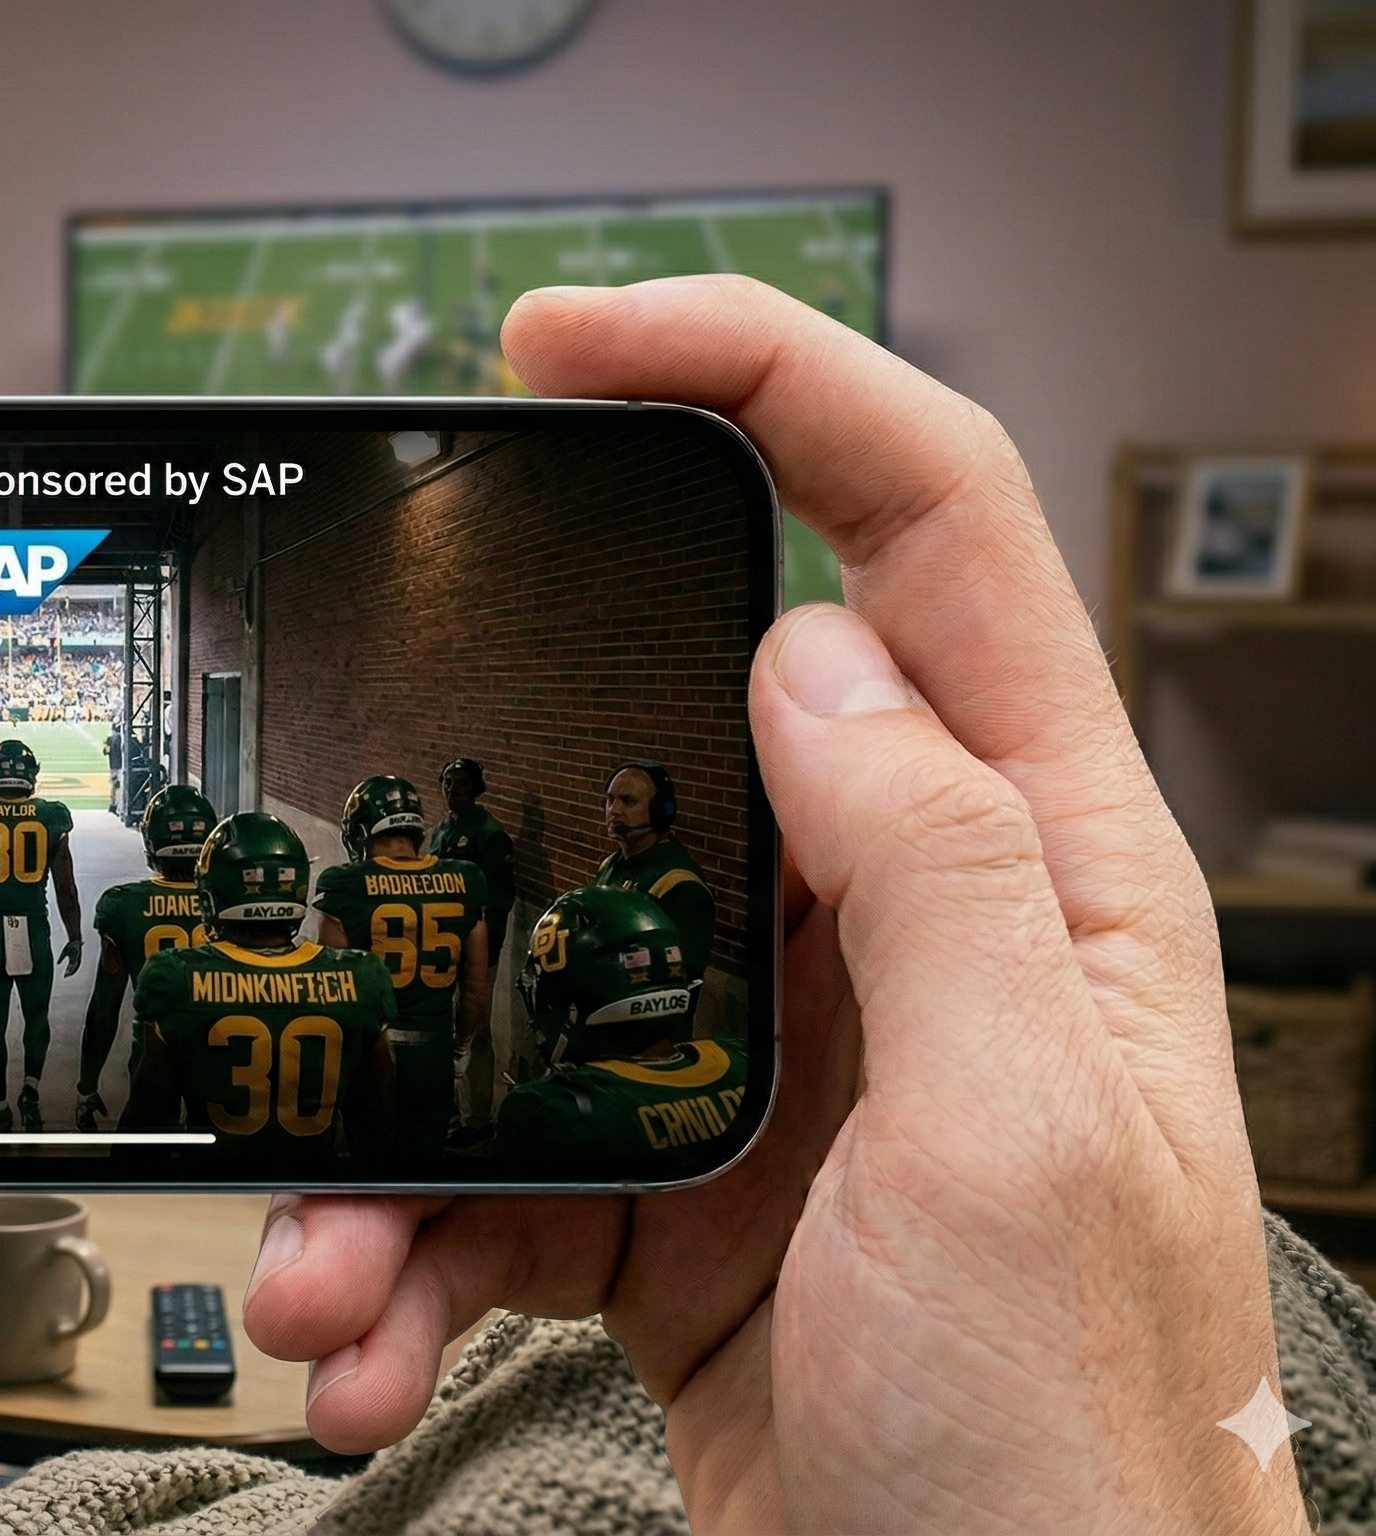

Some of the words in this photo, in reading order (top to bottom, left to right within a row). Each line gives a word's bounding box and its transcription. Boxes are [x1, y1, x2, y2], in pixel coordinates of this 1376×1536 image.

[165, 462, 210, 505] by
[223, 462, 305, 497] SAP
[207, 1015, 343, 1136] 30
